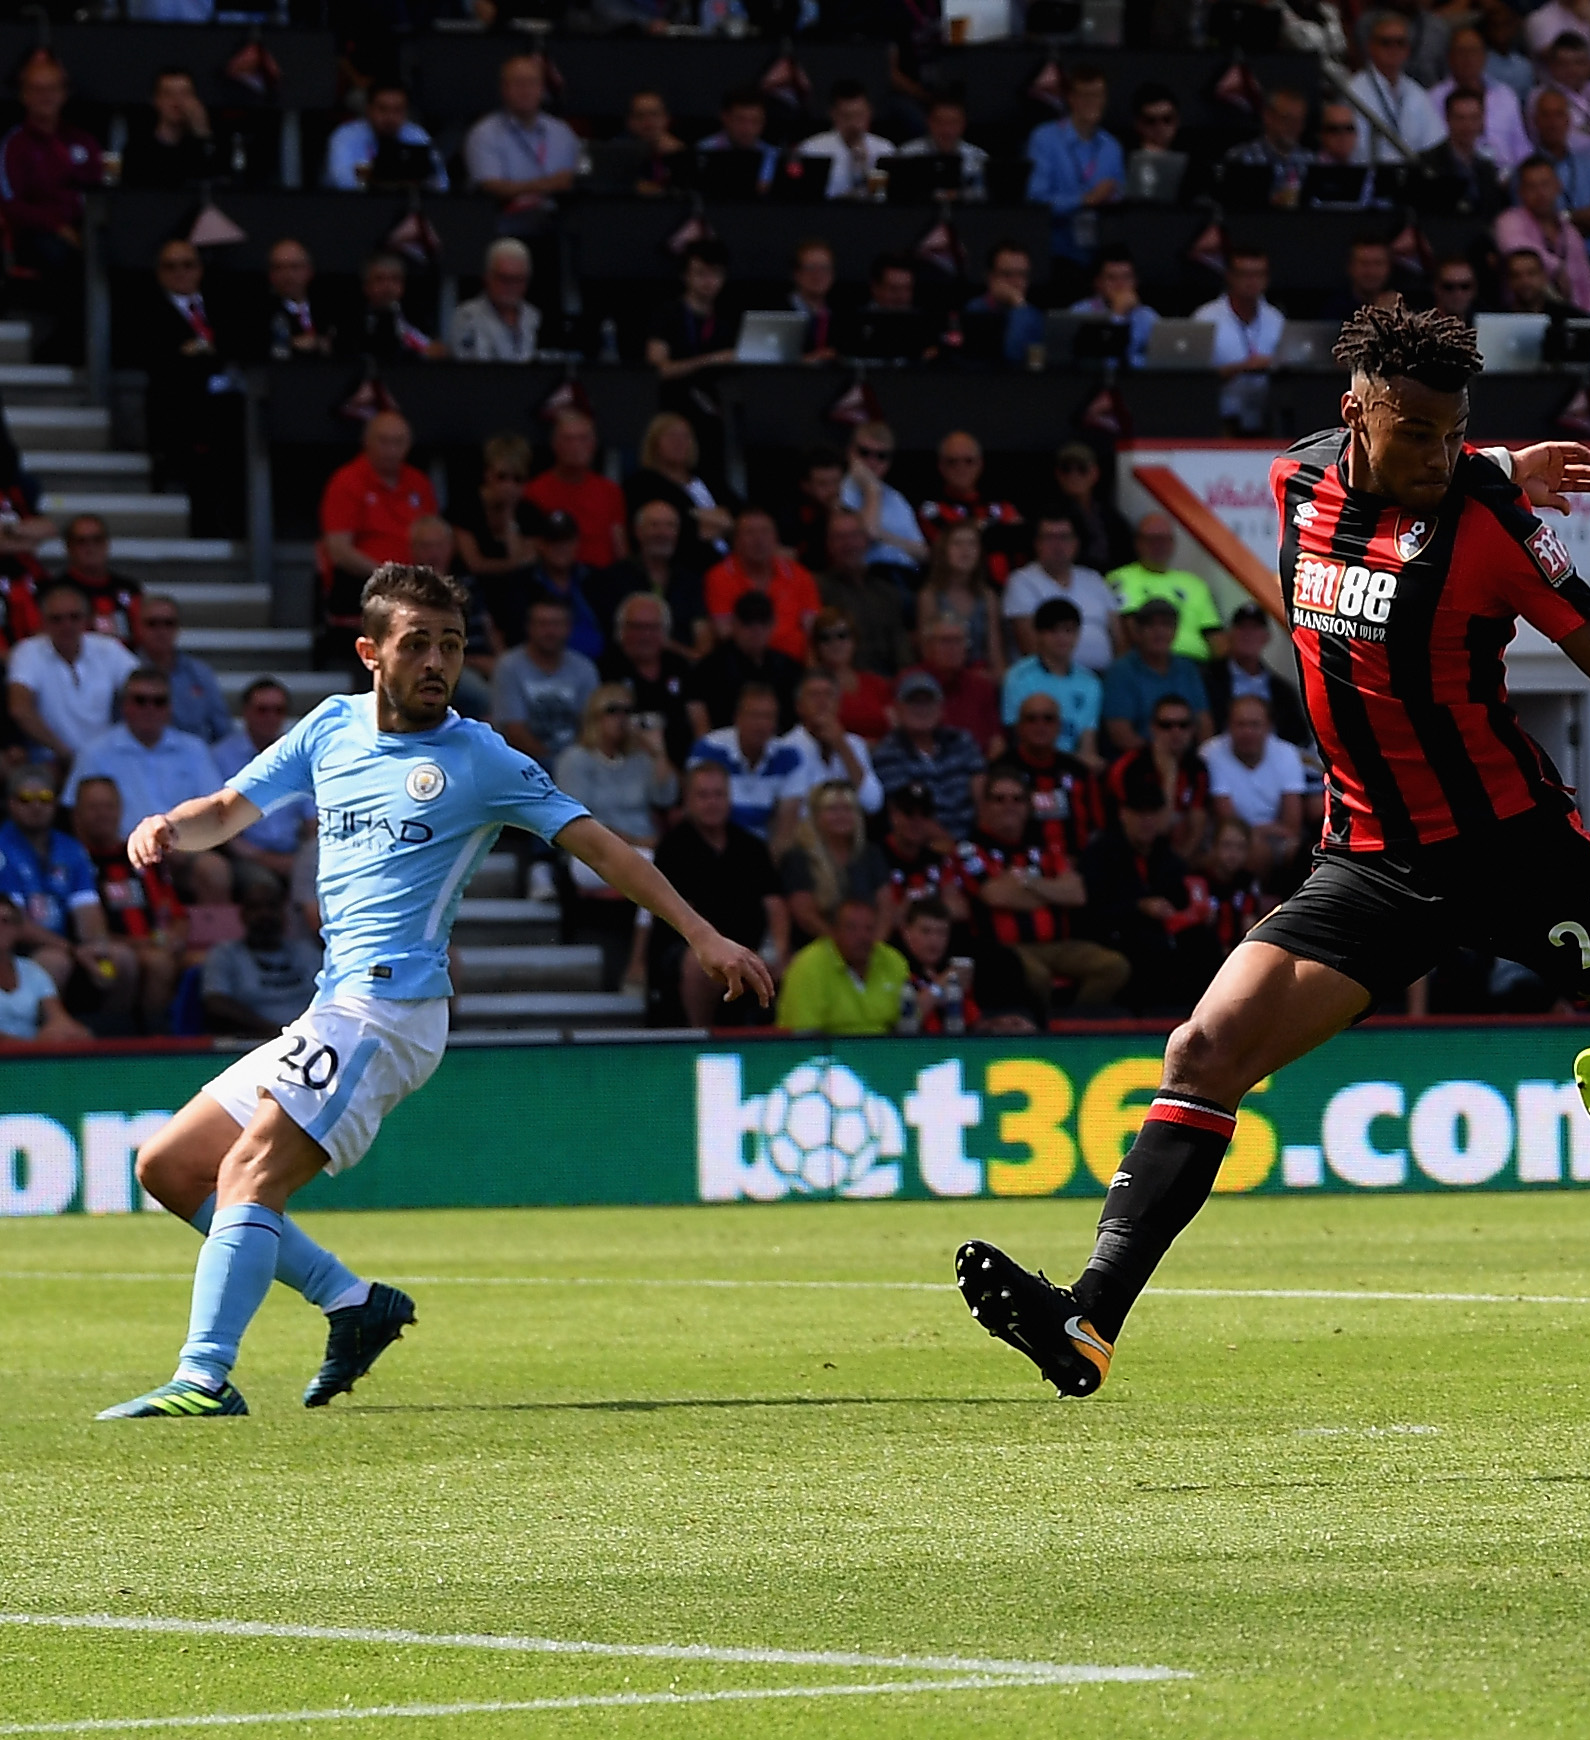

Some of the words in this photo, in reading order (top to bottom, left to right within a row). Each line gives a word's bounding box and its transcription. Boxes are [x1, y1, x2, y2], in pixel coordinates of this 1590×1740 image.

[1293, 608, 1358, 638] MANSION
[319, 807, 434, 845] TIHAD
[278, 1034, 340, 1090] 20
